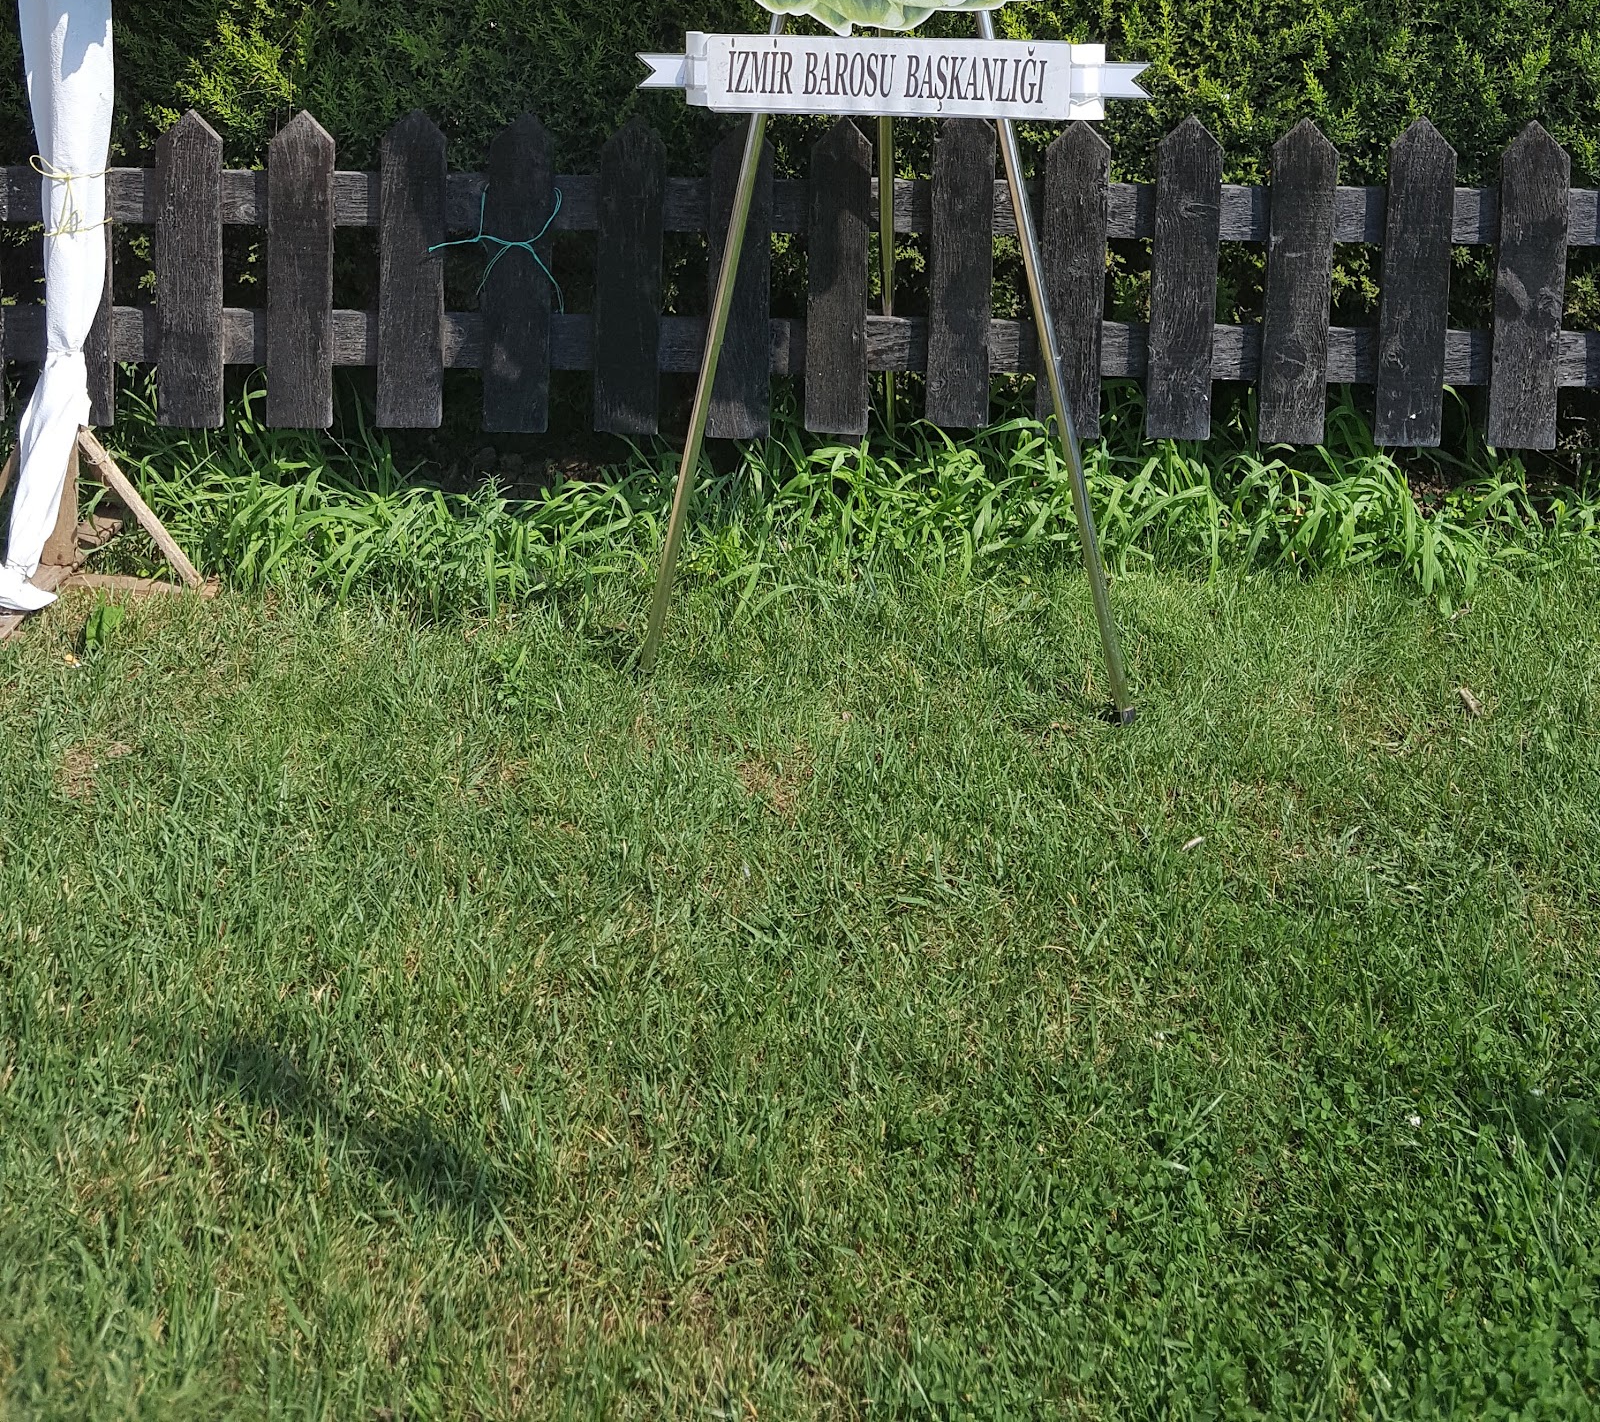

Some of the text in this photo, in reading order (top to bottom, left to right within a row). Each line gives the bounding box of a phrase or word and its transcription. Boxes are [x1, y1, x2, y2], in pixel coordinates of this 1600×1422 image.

[726, 37, 1048, 112] İZMİR BAROSU BAŞKANLIĞI
